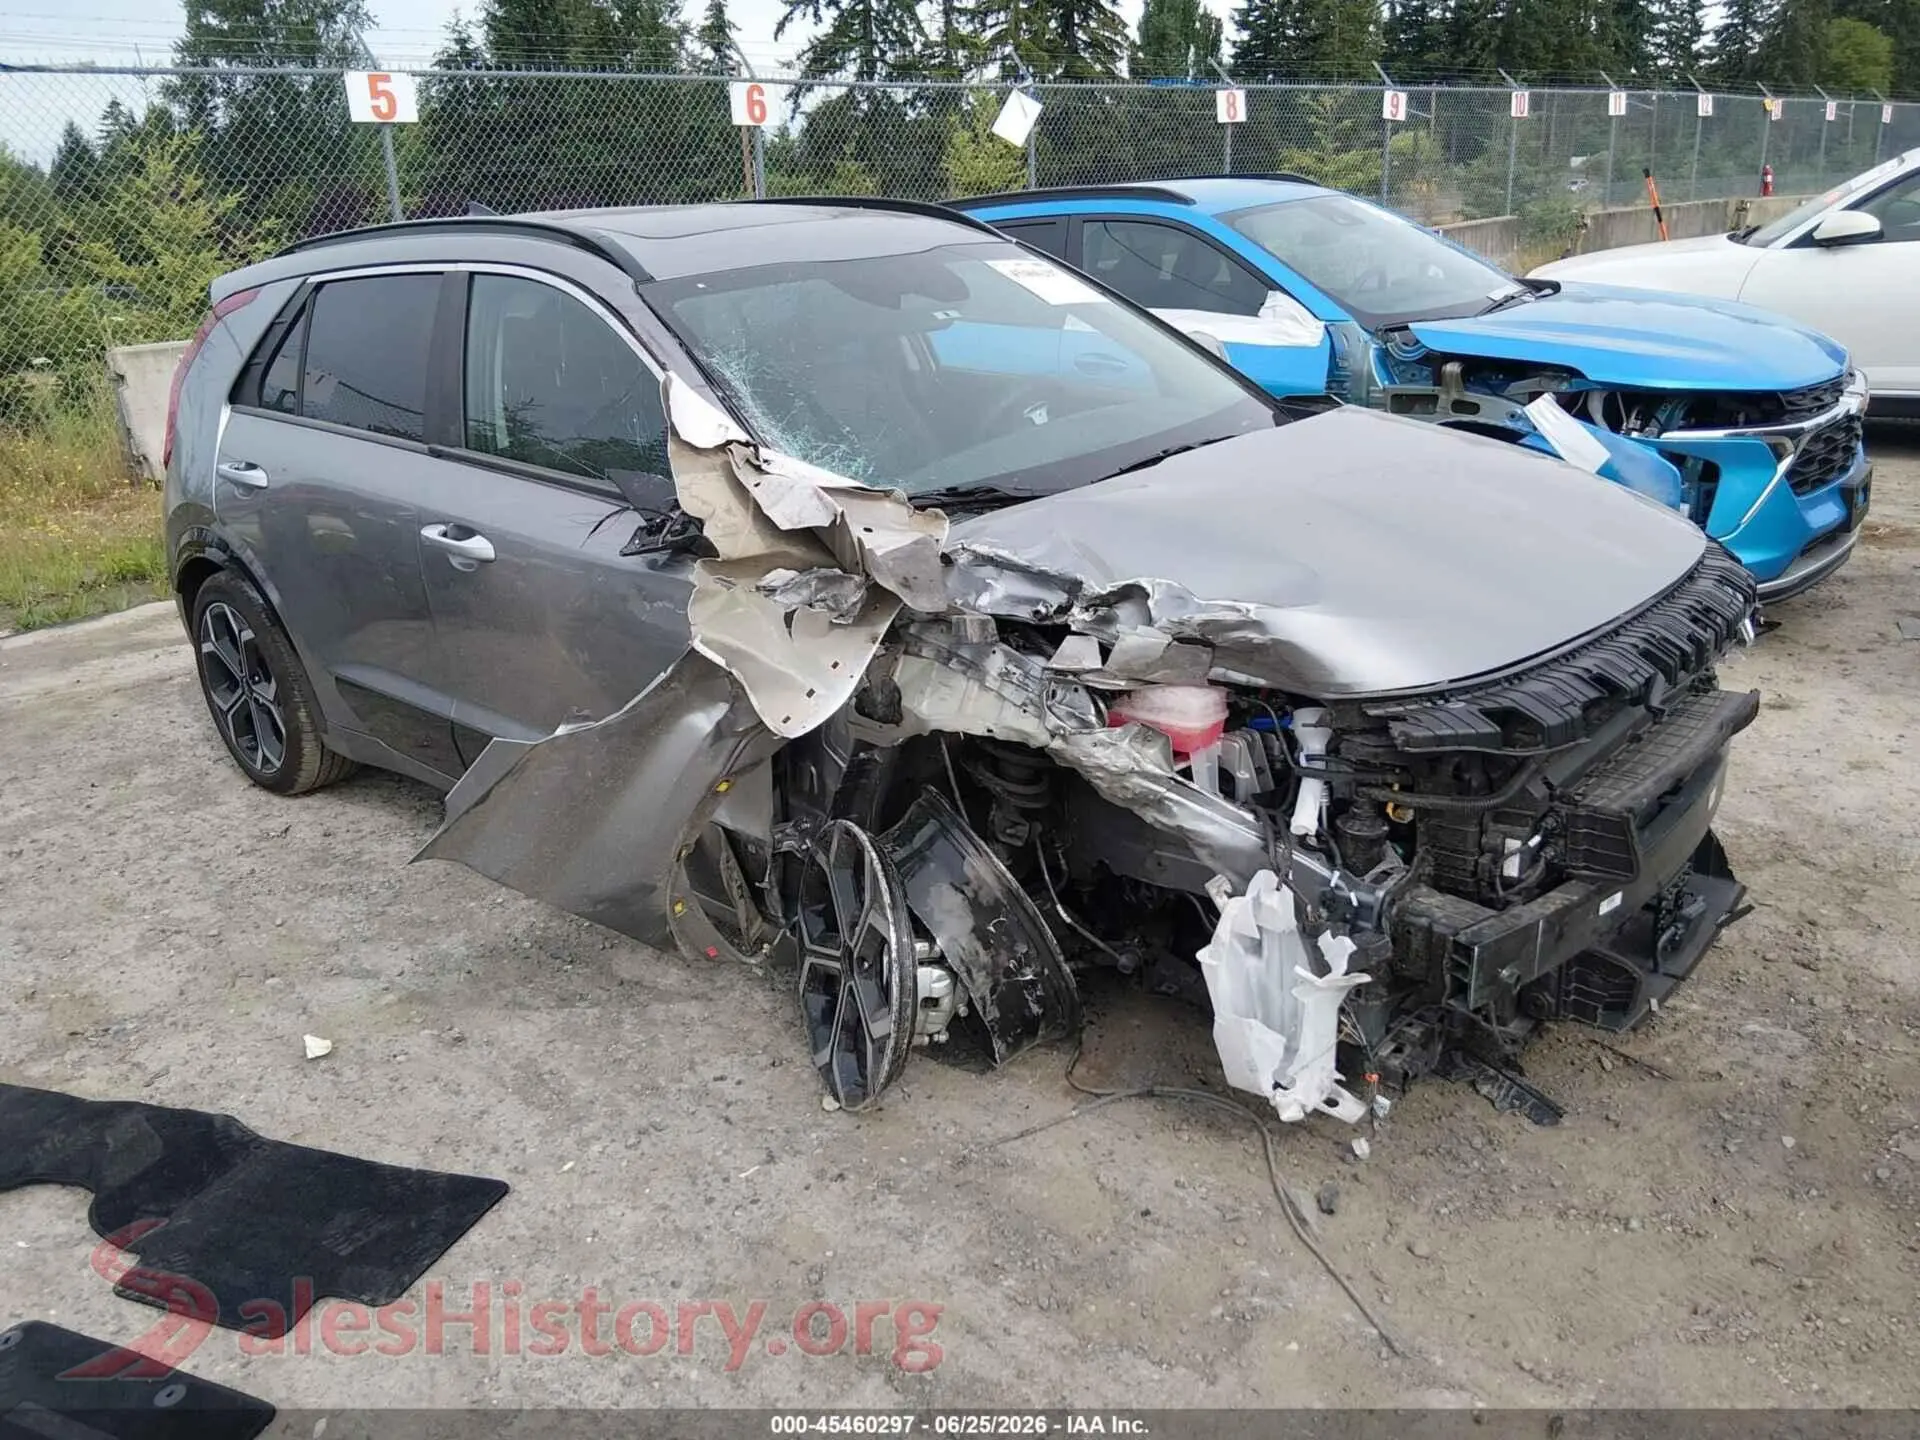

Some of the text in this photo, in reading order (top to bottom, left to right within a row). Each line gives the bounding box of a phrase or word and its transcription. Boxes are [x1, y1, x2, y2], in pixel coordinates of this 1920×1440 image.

[367, 73, 398, 122] 5
[745, 83, 767, 125] 6
[1226, 91, 1238, 121] 8
[1389, 93, 1400, 119] 9
[1514, 93, 1527, 117] 10
